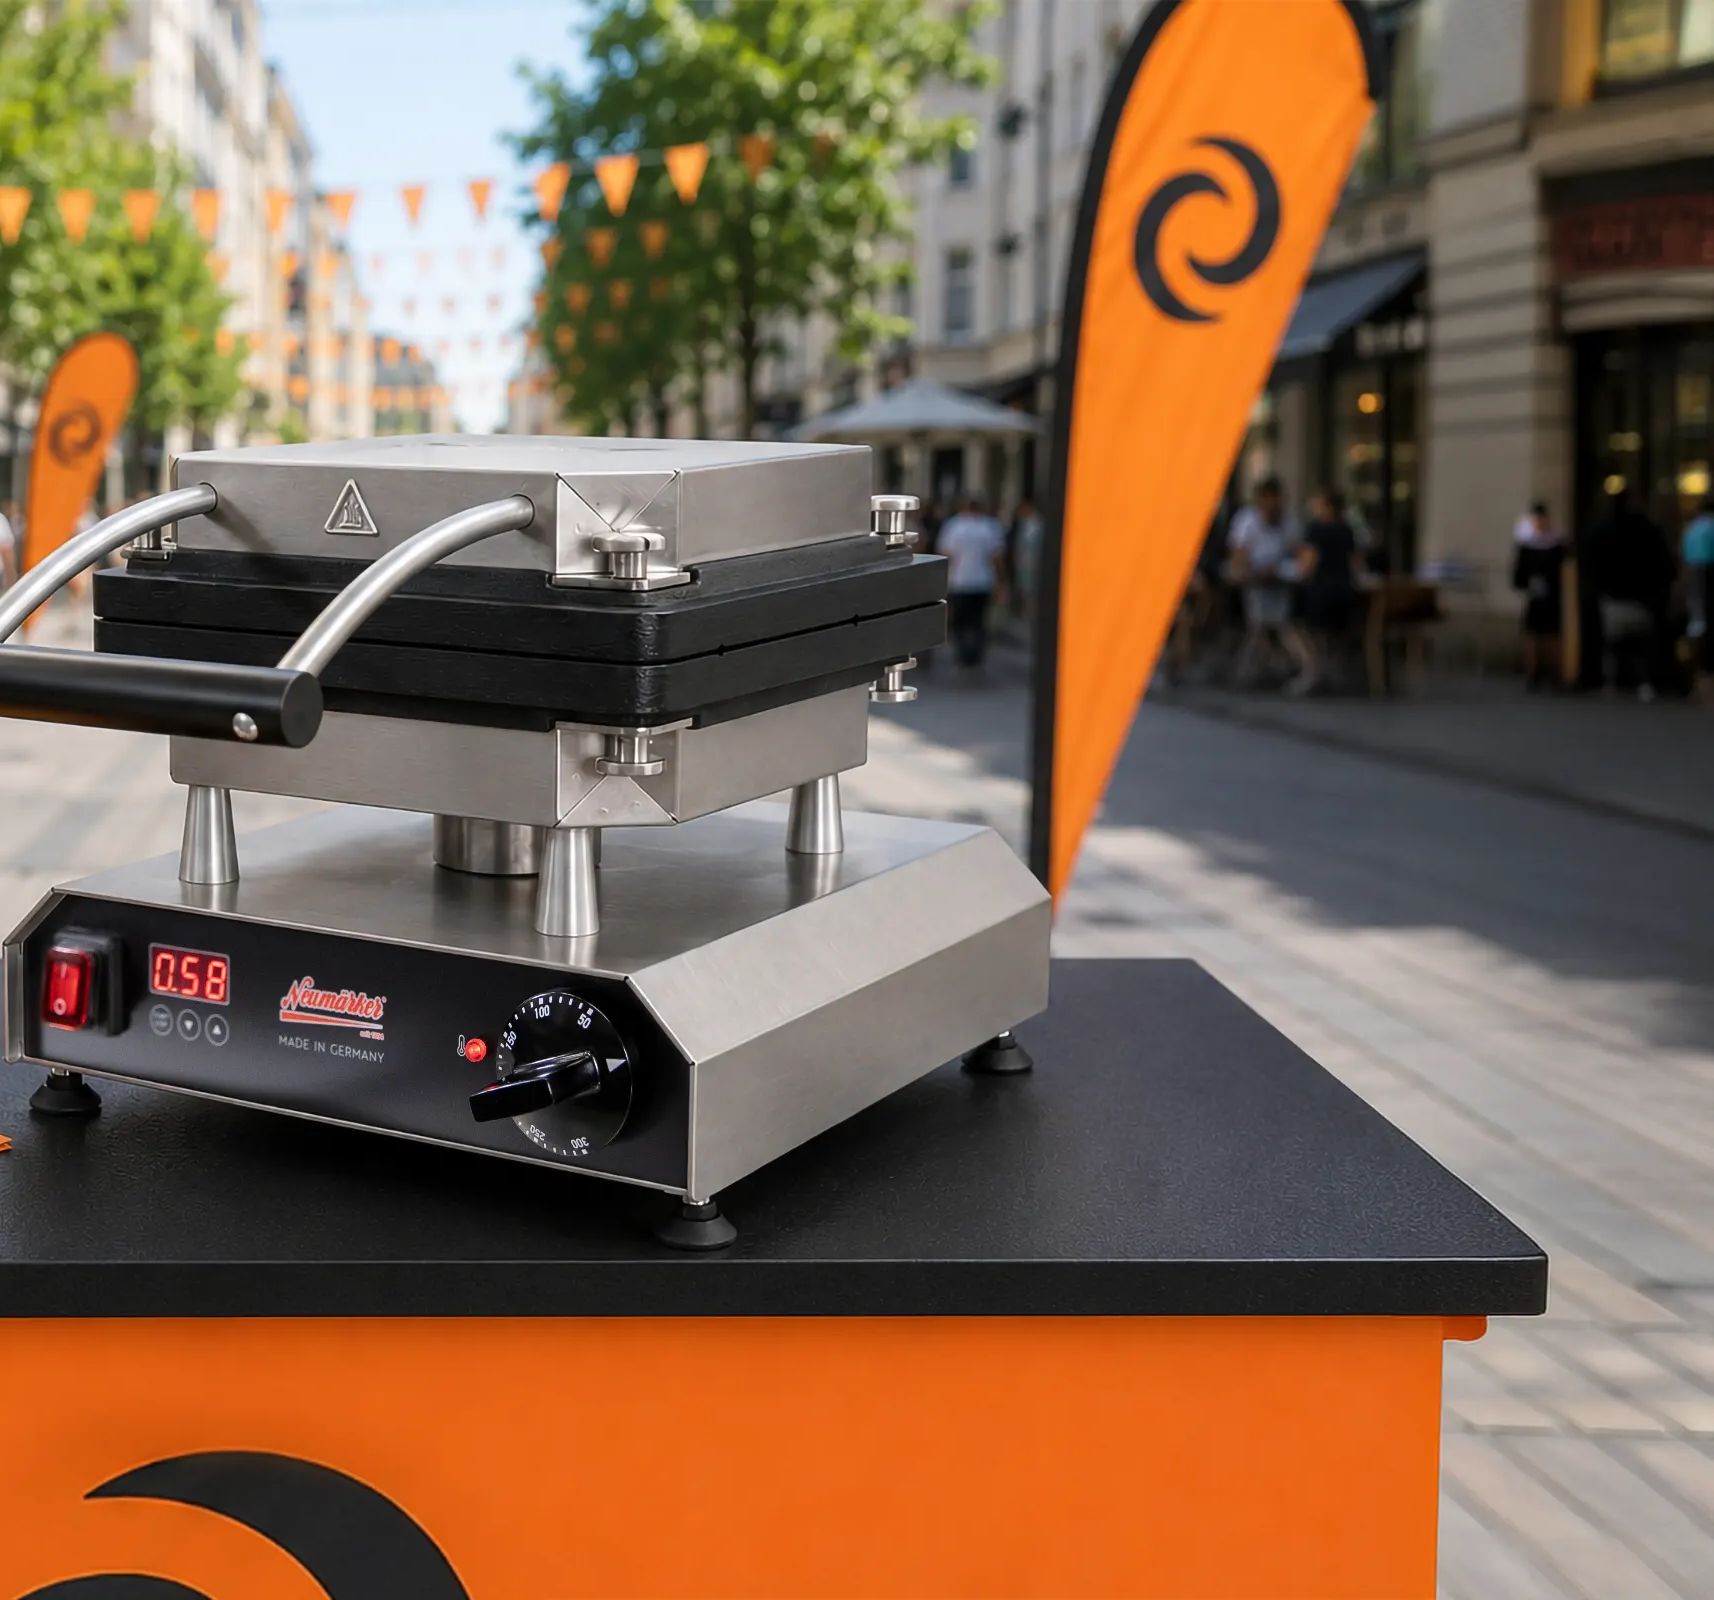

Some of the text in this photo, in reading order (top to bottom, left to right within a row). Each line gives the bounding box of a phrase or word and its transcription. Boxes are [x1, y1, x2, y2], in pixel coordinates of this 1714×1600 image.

[154, 953, 227, 1000] 0.58
[280, 976, 385, 1020] Neumärker
[534, 1005, 550, 1019] 100
[577, 1013, 591, 1029] 50
[278, 1035, 384, 1063] MADE IN GERMANY
[505, 1031, 517, 1050] 150
[529, 1124, 546, 1141] 250
[571, 1137, 590, 1149] 300
